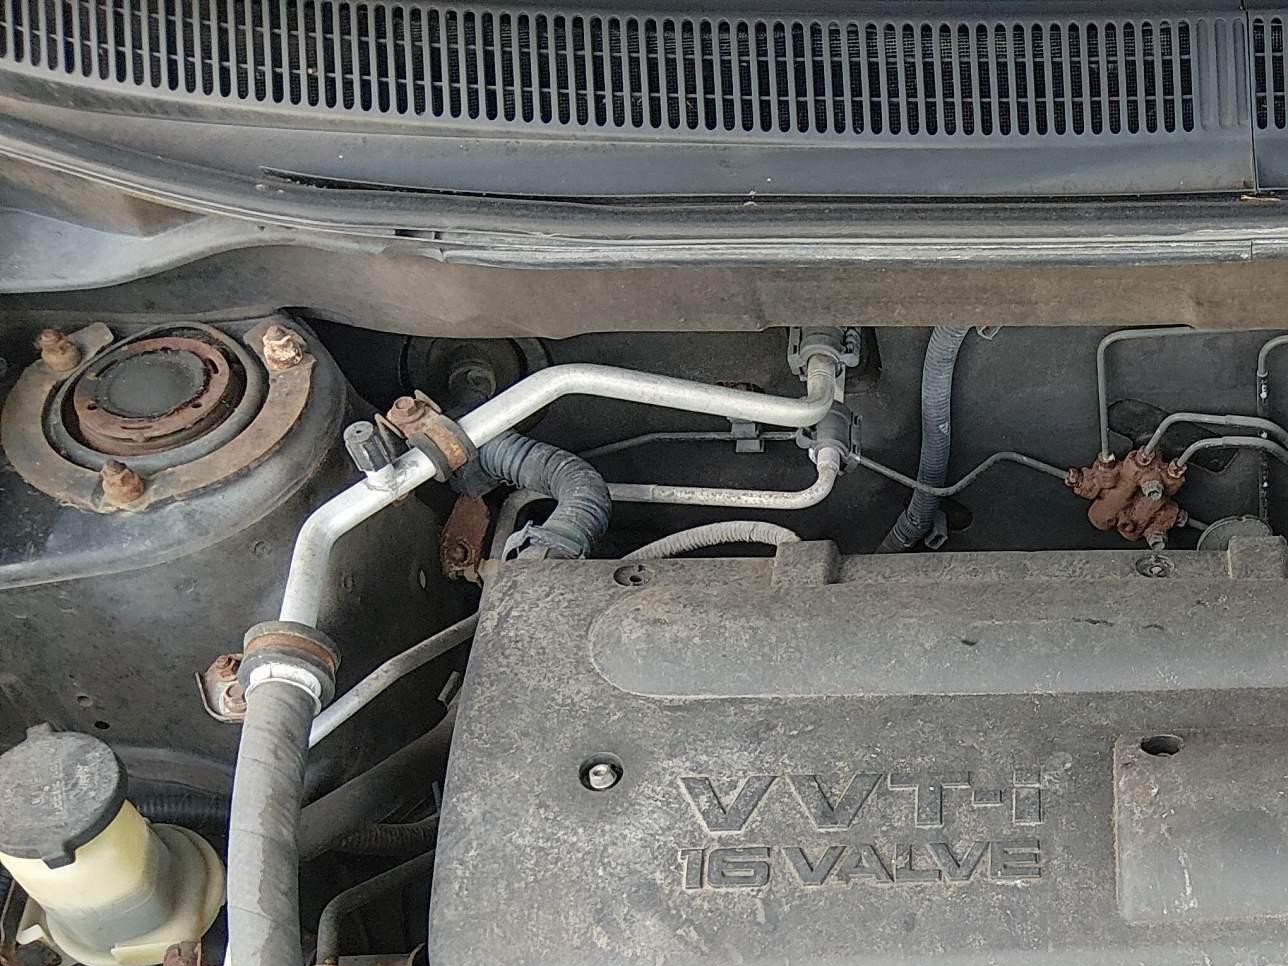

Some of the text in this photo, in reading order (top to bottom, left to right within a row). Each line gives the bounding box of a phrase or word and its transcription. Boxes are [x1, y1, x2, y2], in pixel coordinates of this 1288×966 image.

[679, 770, 1044, 832] VVT-i
[679, 839, 1043, 891] 16 VALVE
